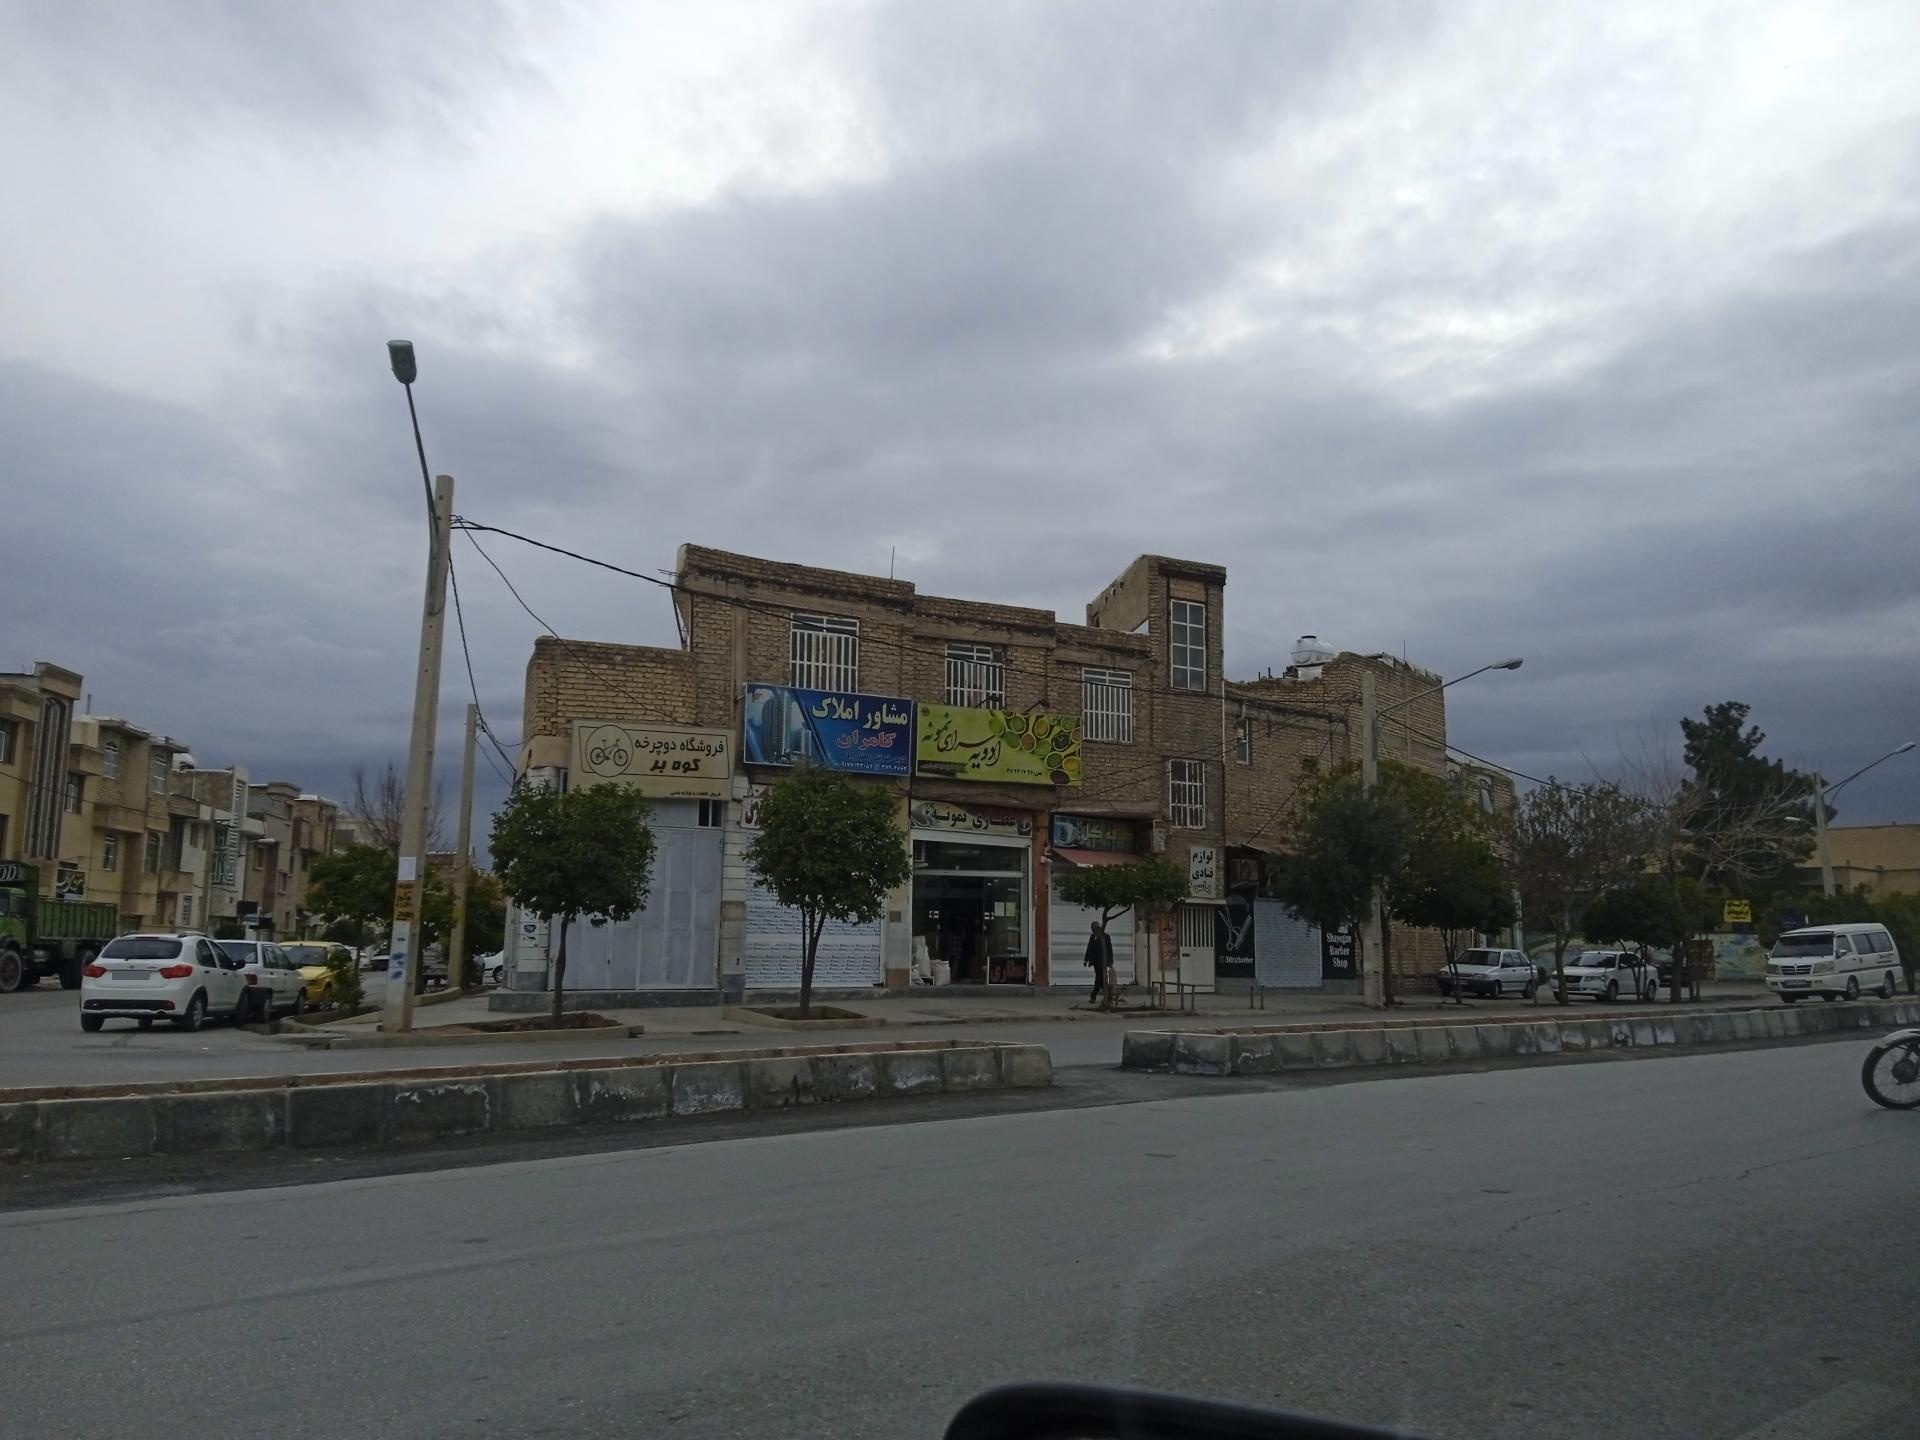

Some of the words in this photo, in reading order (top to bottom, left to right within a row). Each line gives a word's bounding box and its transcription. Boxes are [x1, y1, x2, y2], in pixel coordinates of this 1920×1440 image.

[811, 697, 859, 721] املاک
[862, 703, 908, 730] مشاور
[634, 736, 676, 756] دوچرخه
[680, 737, 724, 758] فروشگاه
[836, 729, 897, 750] کامران
[968, 739, 1001, 768] ادویه
[671, 758, 701, 774] کوه
[1192, 850, 1213, 864] لوازم
[1192, 867, 1214, 880] قنادی
[1328, 945, 1350, 956] Barber
[1332, 957, 1348, 969] Shop
